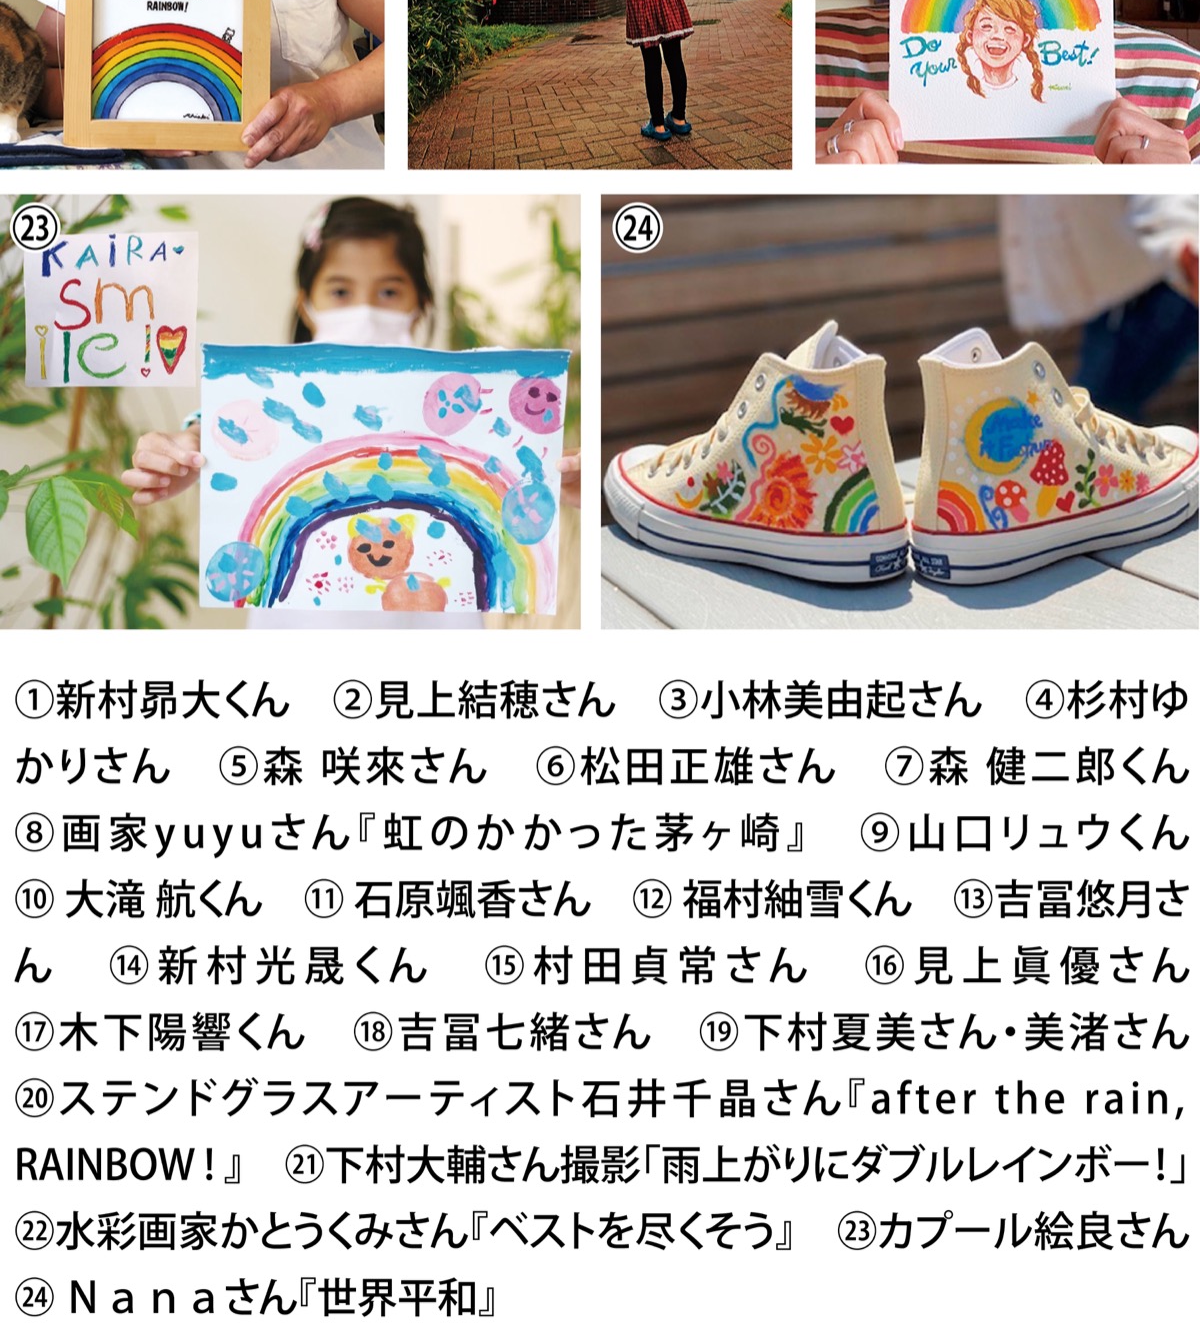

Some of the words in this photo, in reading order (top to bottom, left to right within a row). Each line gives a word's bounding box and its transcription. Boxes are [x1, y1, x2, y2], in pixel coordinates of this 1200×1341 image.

[146, 1, 189, 12] RAINBOW!
[900, 36, 942, 58] Do
[1037, 40, 1100, 66] Best!
